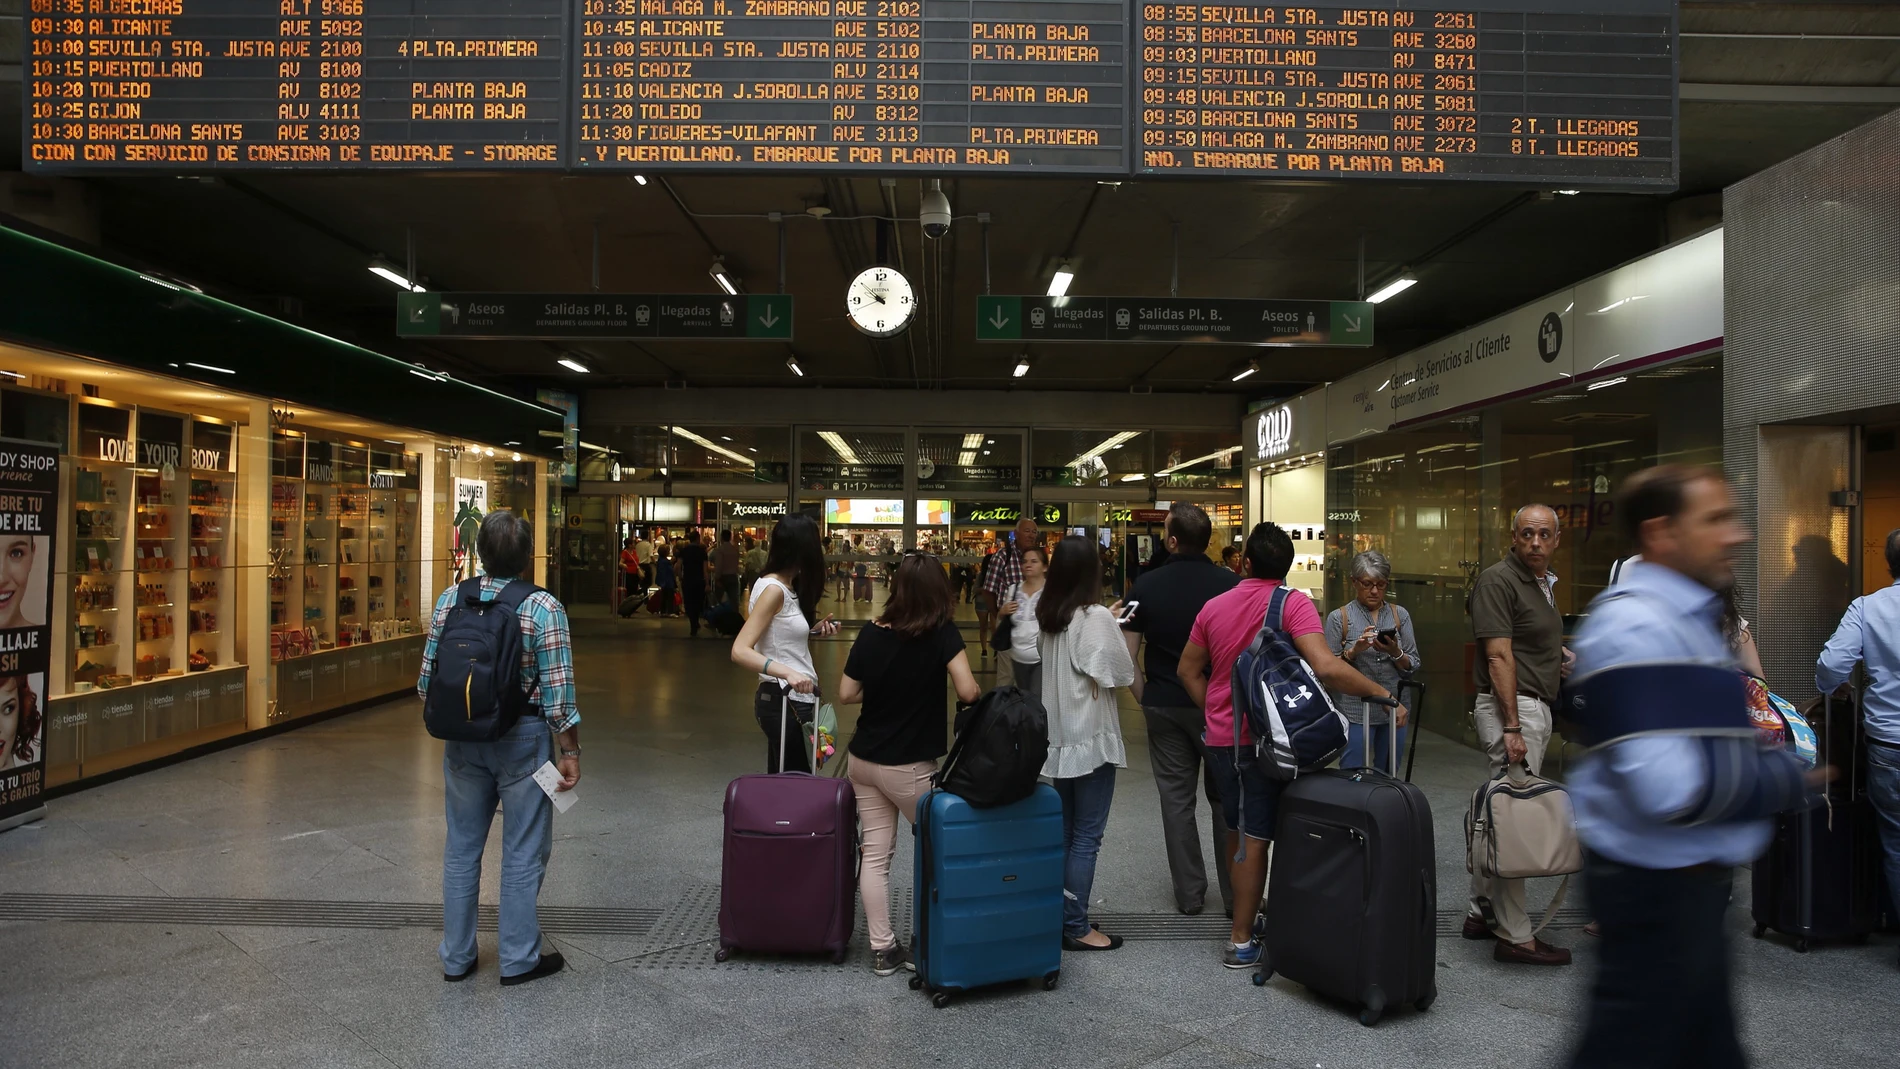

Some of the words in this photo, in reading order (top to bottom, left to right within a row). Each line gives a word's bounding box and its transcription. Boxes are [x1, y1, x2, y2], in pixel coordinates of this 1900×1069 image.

[32, 0, 83, 13] 08:35
[90, 0, 182, 15] ALGECIRAS
[281, 0, 311, 15] ALT
[322, 0, 363, 15] 9366
[585, 0, 635, 15] 10:35
[641, 0, 703, 15] MALAGA
[714, 0, 732, 15] M.
[746, 0, 829, 16] ZAMBRANO
[836, 1, 867, 16] AVE
[878, 2, 920, 17] 2102
[33, 40, 83, 55] 10:00
[89, 40, 161, 56] SEVILLA
[172, 41, 210, 56] STA.
[224, 41, 274, 56] JUSTA
[280, 41, 310, 56] AVE
[321, 41, 361, 56] 2100
[398, 41, 408, 56] 4
[414, 41, 537, 56] PLTA.PRIMERA
[584, 42, 634, 56] 11:00
[640, 42, 713, 58] SEVILLA
[724, 42, 763, 57] STA.
[777, 42, 829, 57] JUSTA
[835, 43, 866, 57] AVE
[877, 43, 919, 58] 2110
[973, 44, 1098, 61] PLTA.PRIMERA
[1144, 47, 1196, 63] 09:03
[1202, 48, 1316, 65] PUERTOLLANO
[1394, 53, 1414, 68] AV
[1435, 54, 1475, 69] 8471
[583, 63, 633, 77] 11:05
[640, 62, 691, 77] CADIZ
[835, 63, 866, 78] ALV
[877, 64, 919, 79] 2114
[33, 82, 83, 97] 10:20
[90, 82, 150, 98] TOLEDO
[279, 83, 299, 98] AV
[320, 83, 360, 98] 8102
[413, 83, 474, 98] PLANTA
[485, 82, 526, 98] BAJA
[583, 83, 633, 98] 11:10
[639, 83, 722, 99] VALENCIA
[734, 84, 828, 99] J.SOROLLA
[834, 84, 865, 99] AVE
[877, 85, 918, 100] 5310
[972, 86, 1035, 102] PLANTA
[1046, 87, 1088, 103] BAJA
[1144, 109, 1196, 125] 09:50
[1202, 111, 1295, 127] BARCELONA
[1306, 113, 1357, 129] SANTS
[1394, 115, 1424, 131] AVE
[1436, 116, 1475, 132] 3072
[1512, 118, 1521, 133] 2
[1529, 119, 1544, 133] T.
[1558, 120, 1638, 136] LLEGADAS
[33, 124, 83, 139] 10:30
[89, 124, 181, 140] BARCELONA
[192, 125, 242, 140] SANTS
[279, 125, 308, 140] AVE
[320, 125, 360, 140] 3103
[582, 125, 632, 140] 11:30
[638, 125, 816, 141] FIGUERES-VILAFANT
[834, 126, 864, 141] AVE
[877, 127, 918, 142] 3113
[972, 128, 1098, 145] PLTA.PRIMERA
[32, 144, 74, 160] CION
[84, 145, 115, 160] CON
[125, 145, 207, 161] SERVICIO
[217, 145, 238, 161] DE
[248, 145, 330, 161] CONSIGNA
[340, 146, 360, 161] DE
[371, 145, 453, 161] EQUIPAJE
[484, 145, 557, 161] STORAGE
[1194, 152, 1278, 169] EMBARQUE
[1287, 154, 1320, 170] POR
[1329, 155, 1392, 171] PLANTA
[1401, 157, 1444, 172] BAJA
[875, 273, 887, 281] 12
[853, 297, 861, 305] 9
[900, 296, 909, 304] 3
[469, 303, 505, 315] Aseos
[545, 304, 590, 316] Salidas
[594, 304, 611, 316] Pl.
[615, 304, 627, 316] B.
[661, 305, 711, 318] Llegadas
[1054, 308, 1104, 321] Llegadas
[1139, 308, 1184, 320] Salidas
[1189, 308, 1205, 320] Pl.
[1210, 308, 1223, 321] B.
[1262, 309, 1299, 322] Aseos
[536, 319, 576, 327] DEPARTURES
[876, 320, 885, 328] 6
[1390, 371, 1413, 391] Centro
[1415, 364, 1424, 382] de
[1426, 352, 1462, 378] Servicios
[1464, 342, 1473, 365] al
[1476, 333, 1511, 361] Cliente
[1390, 391, 1417, 410] Customer
[1417, 381, 1440, 402] Service
[1256, 405, 1292, 450] GOLD
[100, 437, 136, 463] LOVE
[144, 442, 180, 467] YOUR
[191, 448, 220, 471] BODY
[0, 470, 33, 482] rience
[309, 463, 334, 481] HANDS
[459, 483, 484, 499] SUMMER
[0, 495, 24, 512] BRE
[28, 496, 43, 512] TU
[15, 514, 41, 531] PIEL
[1, 653, 19, 672] SH
[154, 695, 175, 705] tiendas
[192, 687, 211, 697] tiendas
[111, 703, 133, 714] tiendas
[63, 711, 88, 723] tiendas
[7, 774, 19, 789] TU
[21, 767, 41, 785] TRÍO
[10, 782, 40, 802] GRATIS
